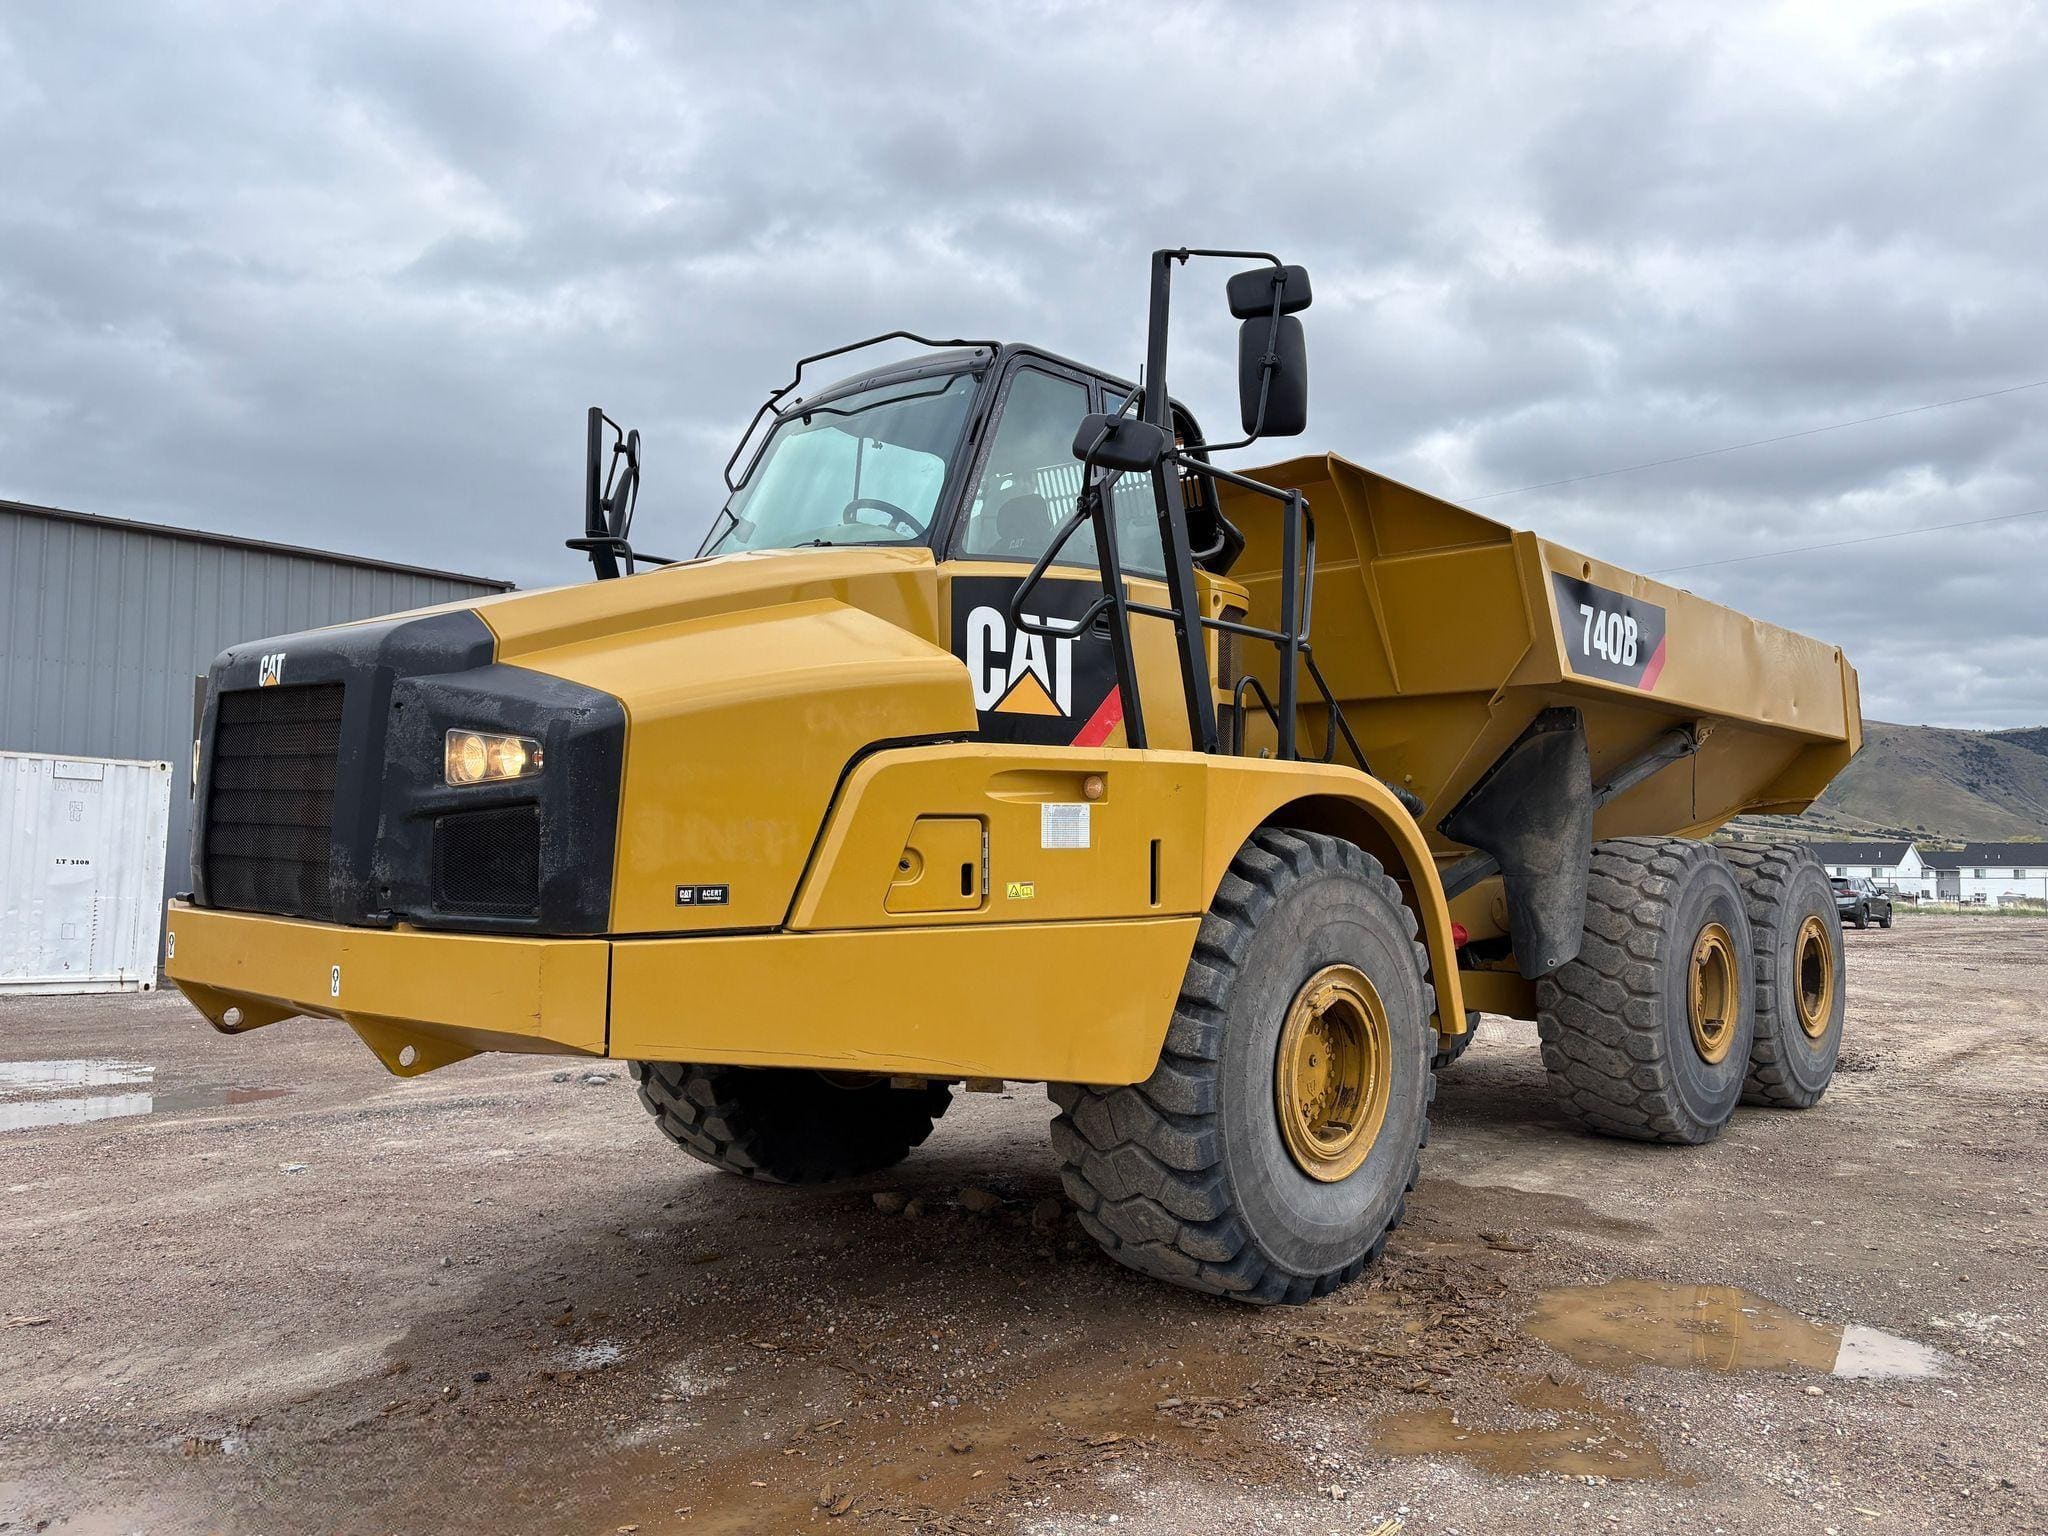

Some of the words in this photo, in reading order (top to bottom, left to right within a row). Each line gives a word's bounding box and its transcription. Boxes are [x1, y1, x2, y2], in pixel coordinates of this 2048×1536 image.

[1580, 603, 1638, 667] 740B
[259, 653, 286, 687] CAT
[967, 606, 1081, 717] CAT
[680, 890, 692, 899] CAT
[702, 889, 722, 897] ACERT
